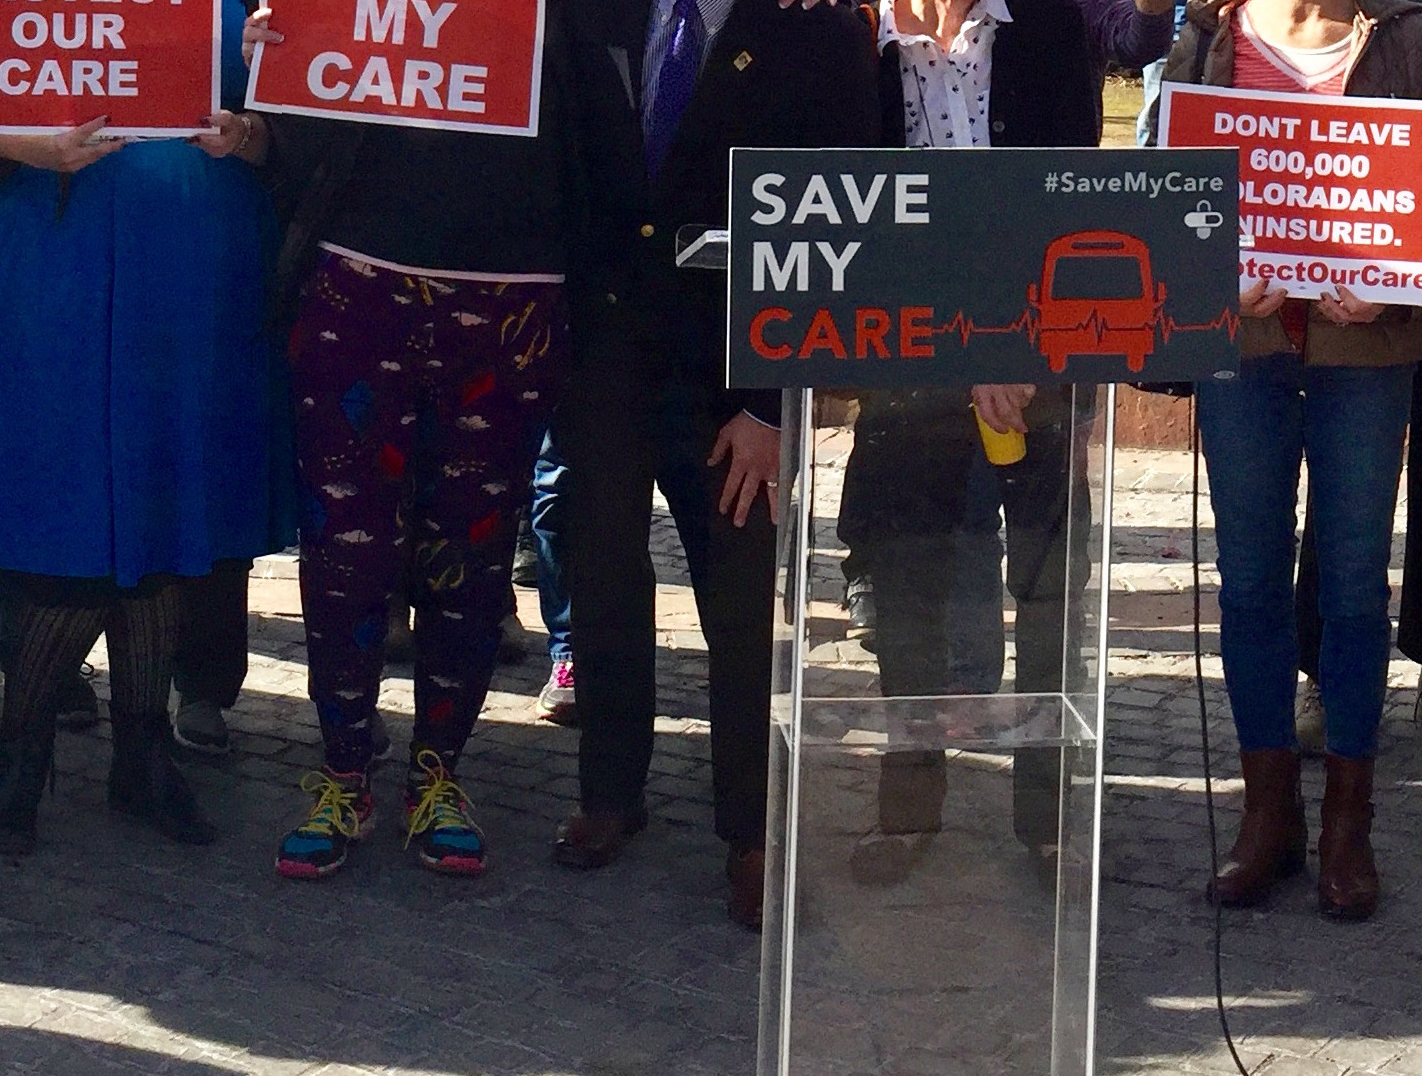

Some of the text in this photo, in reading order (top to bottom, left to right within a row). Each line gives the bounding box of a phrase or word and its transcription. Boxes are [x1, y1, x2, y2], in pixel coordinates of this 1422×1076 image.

[12, 11, 126, 50] OUR
[307, 51, 488, 114] CARE
[1214, 112, 1411, 147] DONT LEAVE
[1250, 148, 1370, 180] 600,000
[750, 172, 930, 225] SAVE
[1044, 170, 1223, 199] #SaveMyCare
[1239, 181, 1416, 214] LORADANS
[1239, 214, 1402, 247] NINSURED.
[752, 240, 862, 292] MY
[749, 306, 935, 360] CARE
